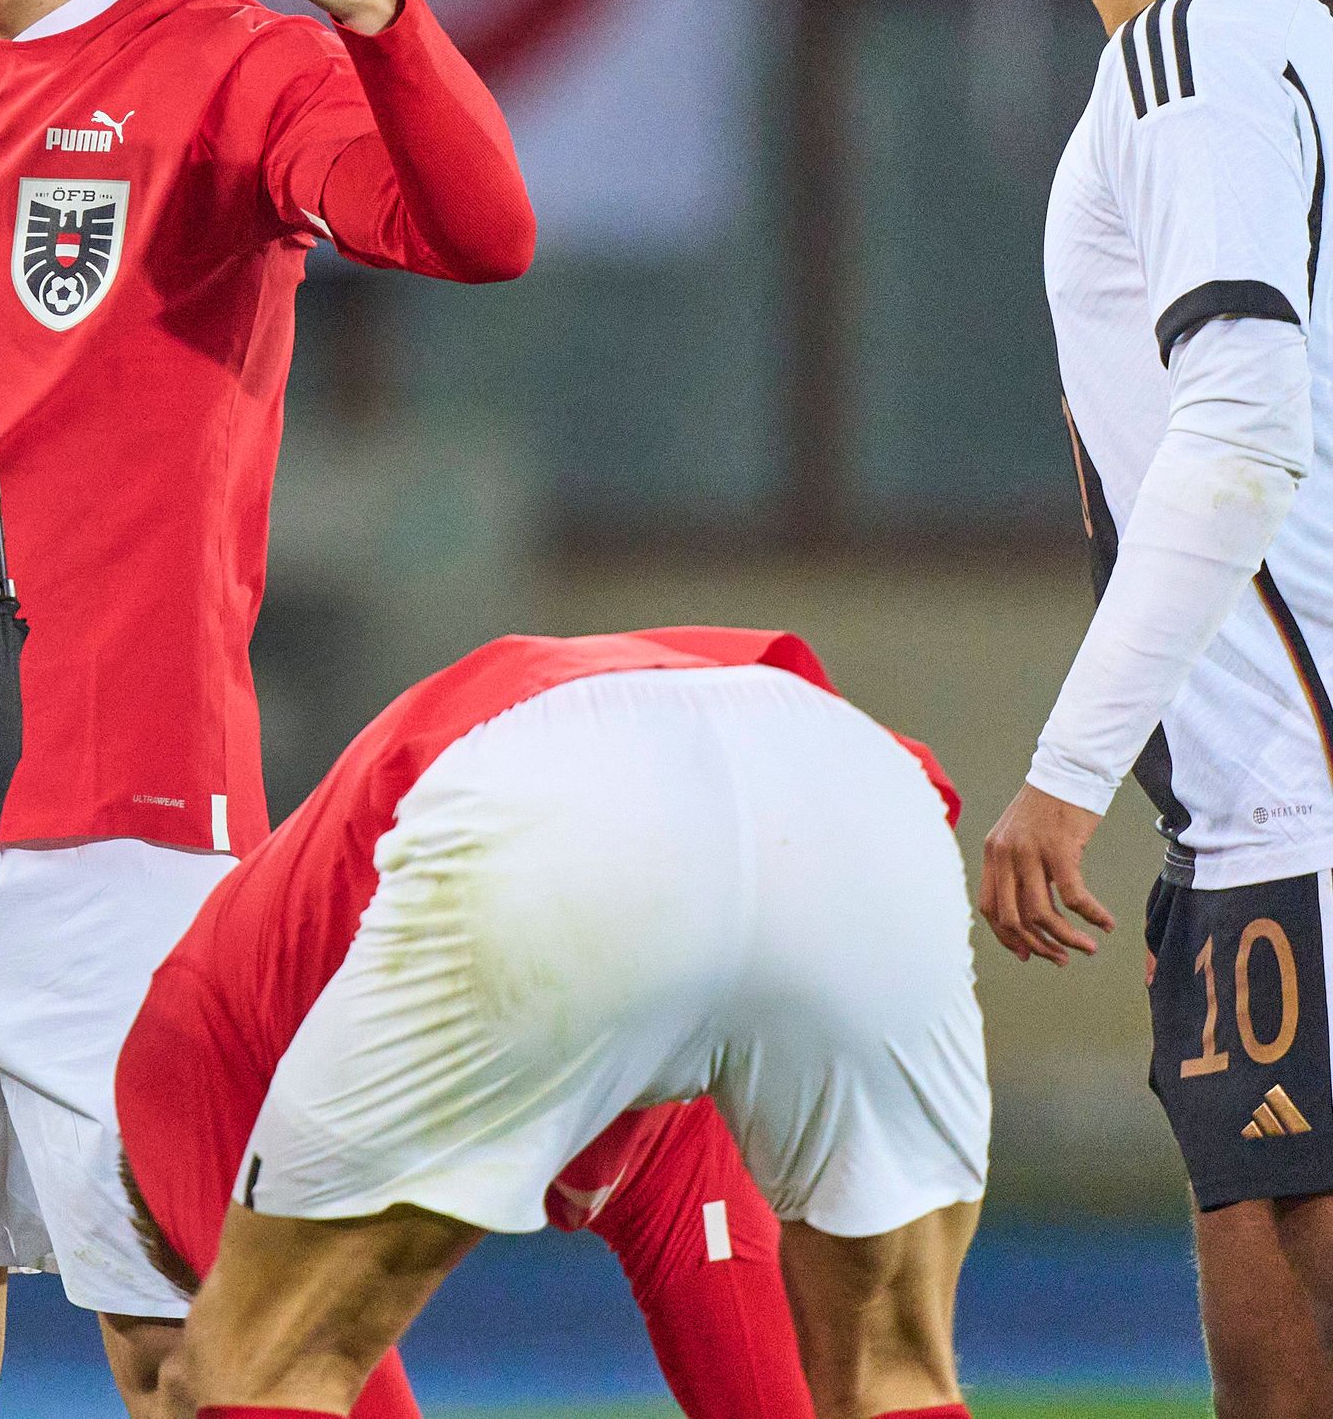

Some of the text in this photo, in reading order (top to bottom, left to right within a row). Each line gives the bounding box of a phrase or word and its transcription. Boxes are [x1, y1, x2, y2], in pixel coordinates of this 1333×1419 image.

[45, 127, 114, 153] PUMA
[52, 186, 96, 202] ÖFB
[1179, 917, 1299, 1080] 10
